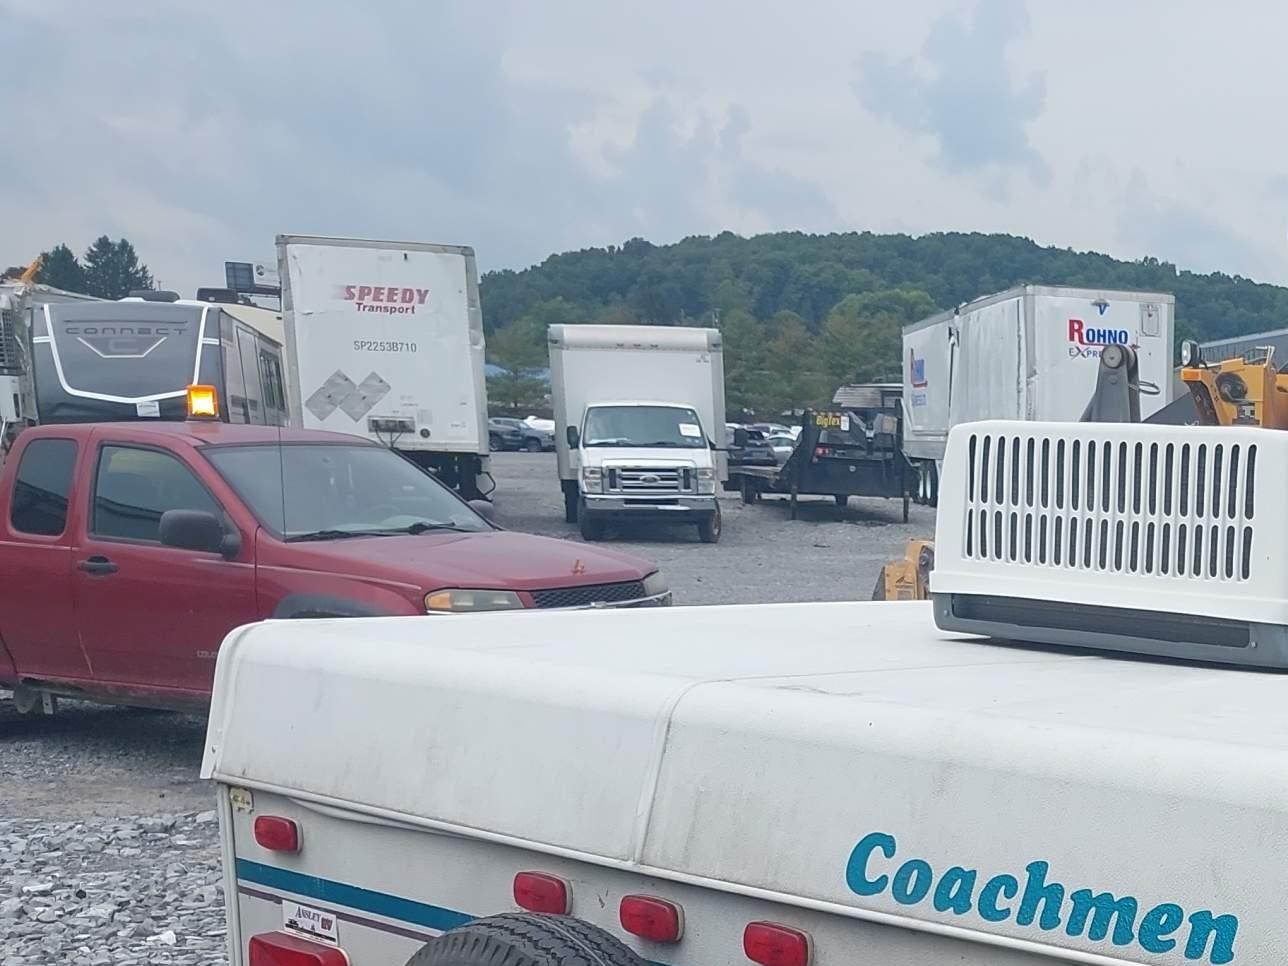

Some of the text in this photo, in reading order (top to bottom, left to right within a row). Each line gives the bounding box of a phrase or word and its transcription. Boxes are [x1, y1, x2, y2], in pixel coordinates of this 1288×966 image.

[343, 285, 430, 304] SPEEDY
[355, 302, 416, 315] Transport
[65, 327, 188, 336] CONNECT
[1068, 319, 1129, 346] ROHNO
[845, 832, 1240, 965] Coachmen
